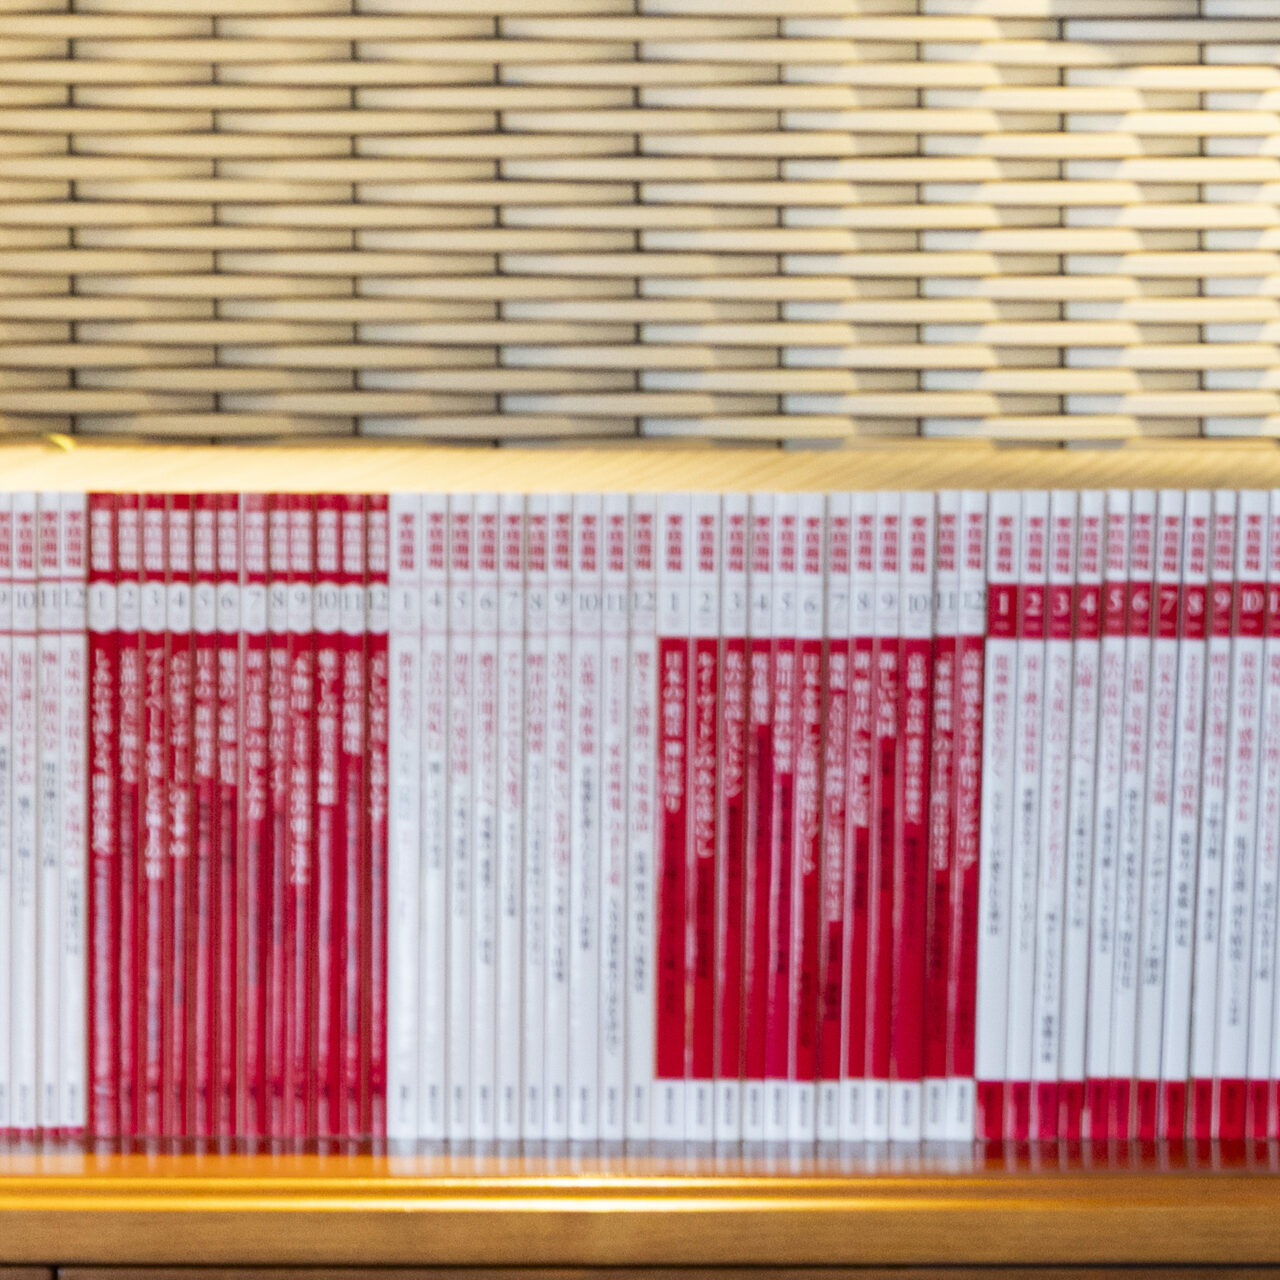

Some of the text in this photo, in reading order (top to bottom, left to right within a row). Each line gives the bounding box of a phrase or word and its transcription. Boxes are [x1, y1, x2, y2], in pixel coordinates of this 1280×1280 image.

[1026, 592, 1043, 616] 2
[1051, 593, 1070, 616] 3
[1078, 592, 1097, 615] 4
[1107, 591, 1124, 612] 5
[1132, 591, 1149, 613] 6
[1160, 592, 1178, 614] 7
[1186, 592, 1204, 615] 8
[1214, 591, 1231, 612] 9
[1241, 591, 1265, 614] 10
